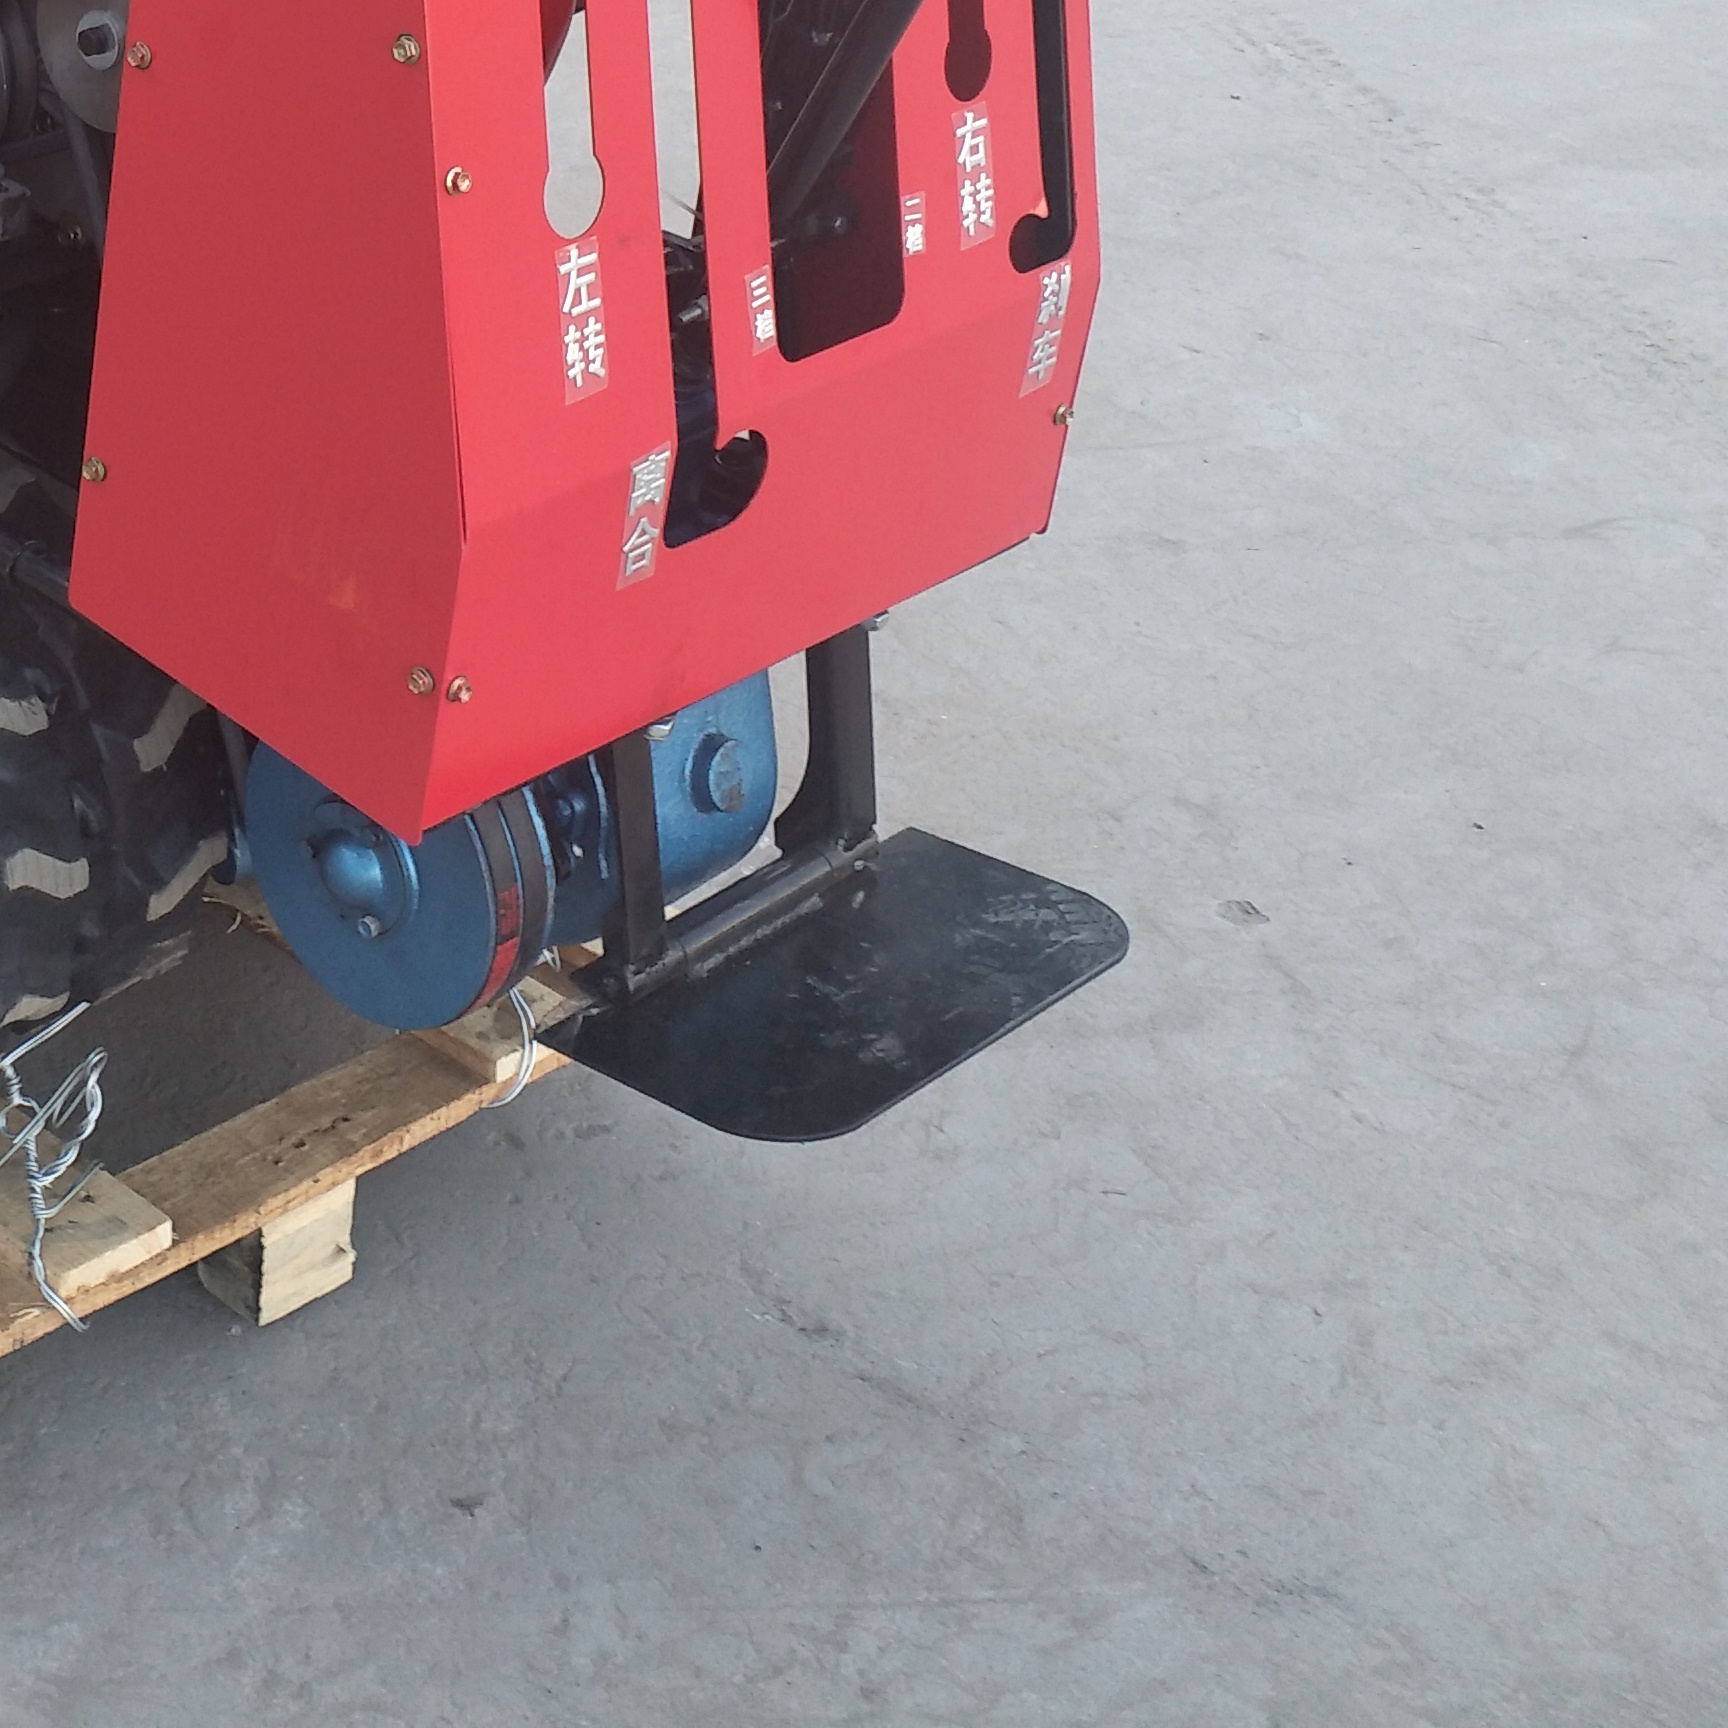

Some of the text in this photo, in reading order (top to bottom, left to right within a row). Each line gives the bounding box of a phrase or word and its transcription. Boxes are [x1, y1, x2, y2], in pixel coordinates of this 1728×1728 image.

[904, 198, 924, 256] 二档
[955, 112, 994, 236] 右转
[557, 245, 606, 388] 左转
[1027, 264, 1071, 381] 刹车
[622, 450, 670, 577] 离合
